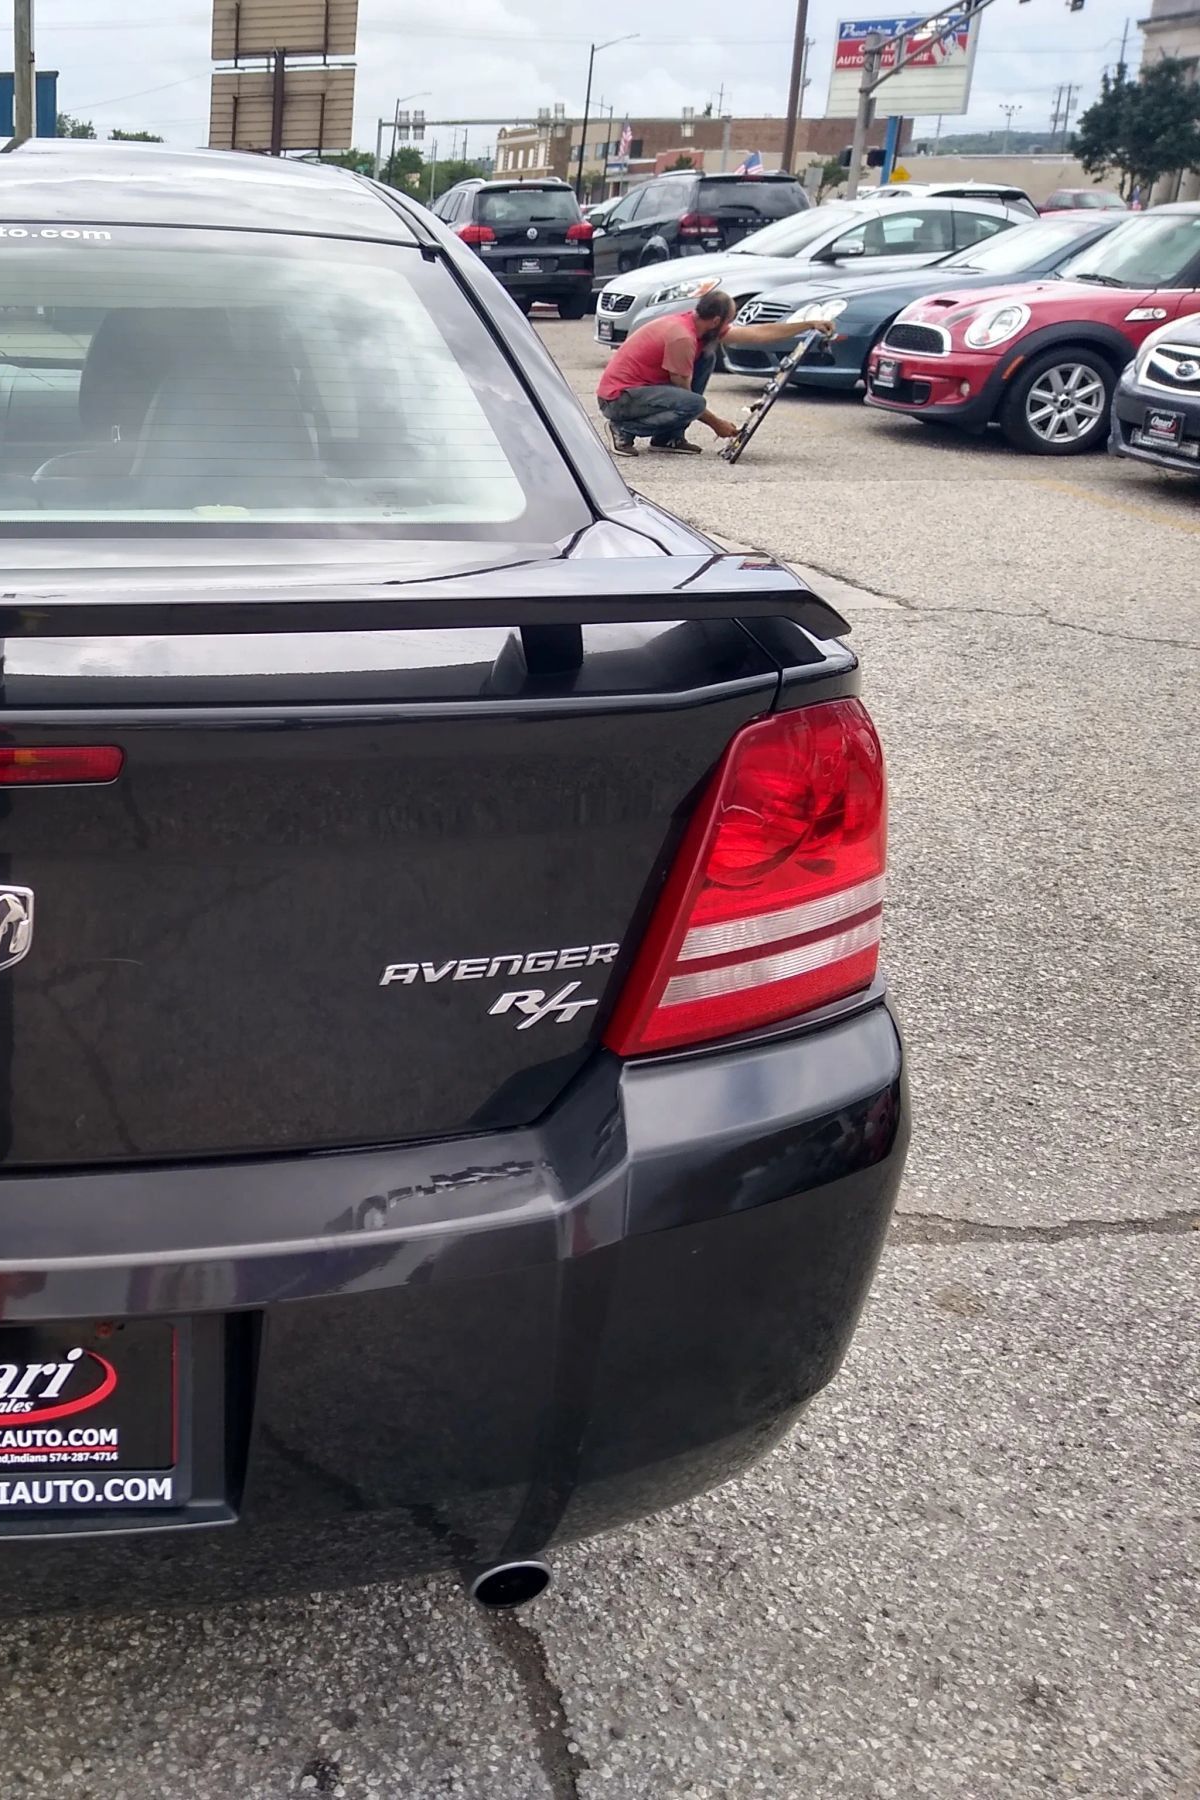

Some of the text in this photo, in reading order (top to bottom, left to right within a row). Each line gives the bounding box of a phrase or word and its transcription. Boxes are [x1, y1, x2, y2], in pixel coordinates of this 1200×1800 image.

[378, 942, 621, 986] AVENGER
[487, 980, 599, 1031] R/T
[49, 1451, 118, 1463] 574-287-4714
